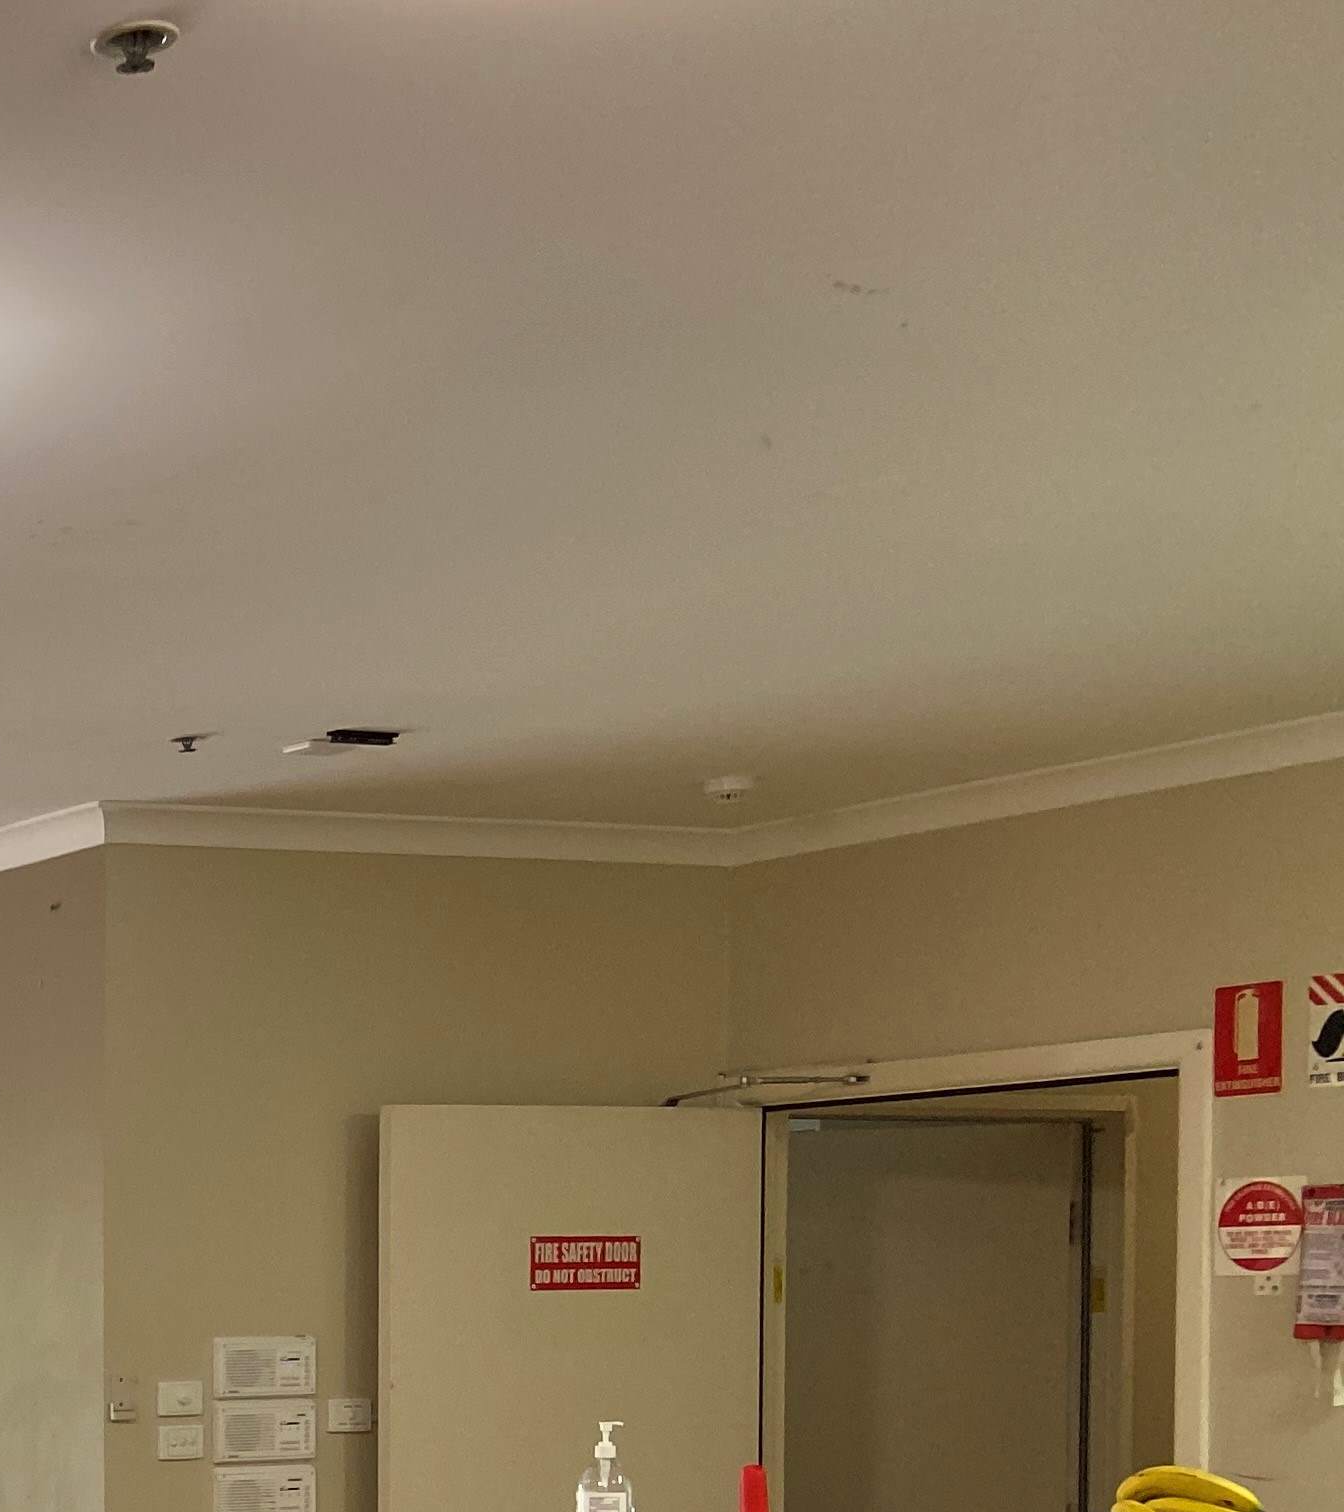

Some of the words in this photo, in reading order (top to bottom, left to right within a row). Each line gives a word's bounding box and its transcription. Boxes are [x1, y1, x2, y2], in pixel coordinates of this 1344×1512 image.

[1239, 1212, 1286, 1223] POWDER
[534, 1242, 559, 1263] FIRE
[561, 1242, 603, 1263] SAFETY
[605, 1241, 637, 1262] DOOR
[534, 1269, 551, 1284] DO
[553, 1269, 576, 1284] NOT
[577, 1268, 637, 1283] OBSTRUCT
